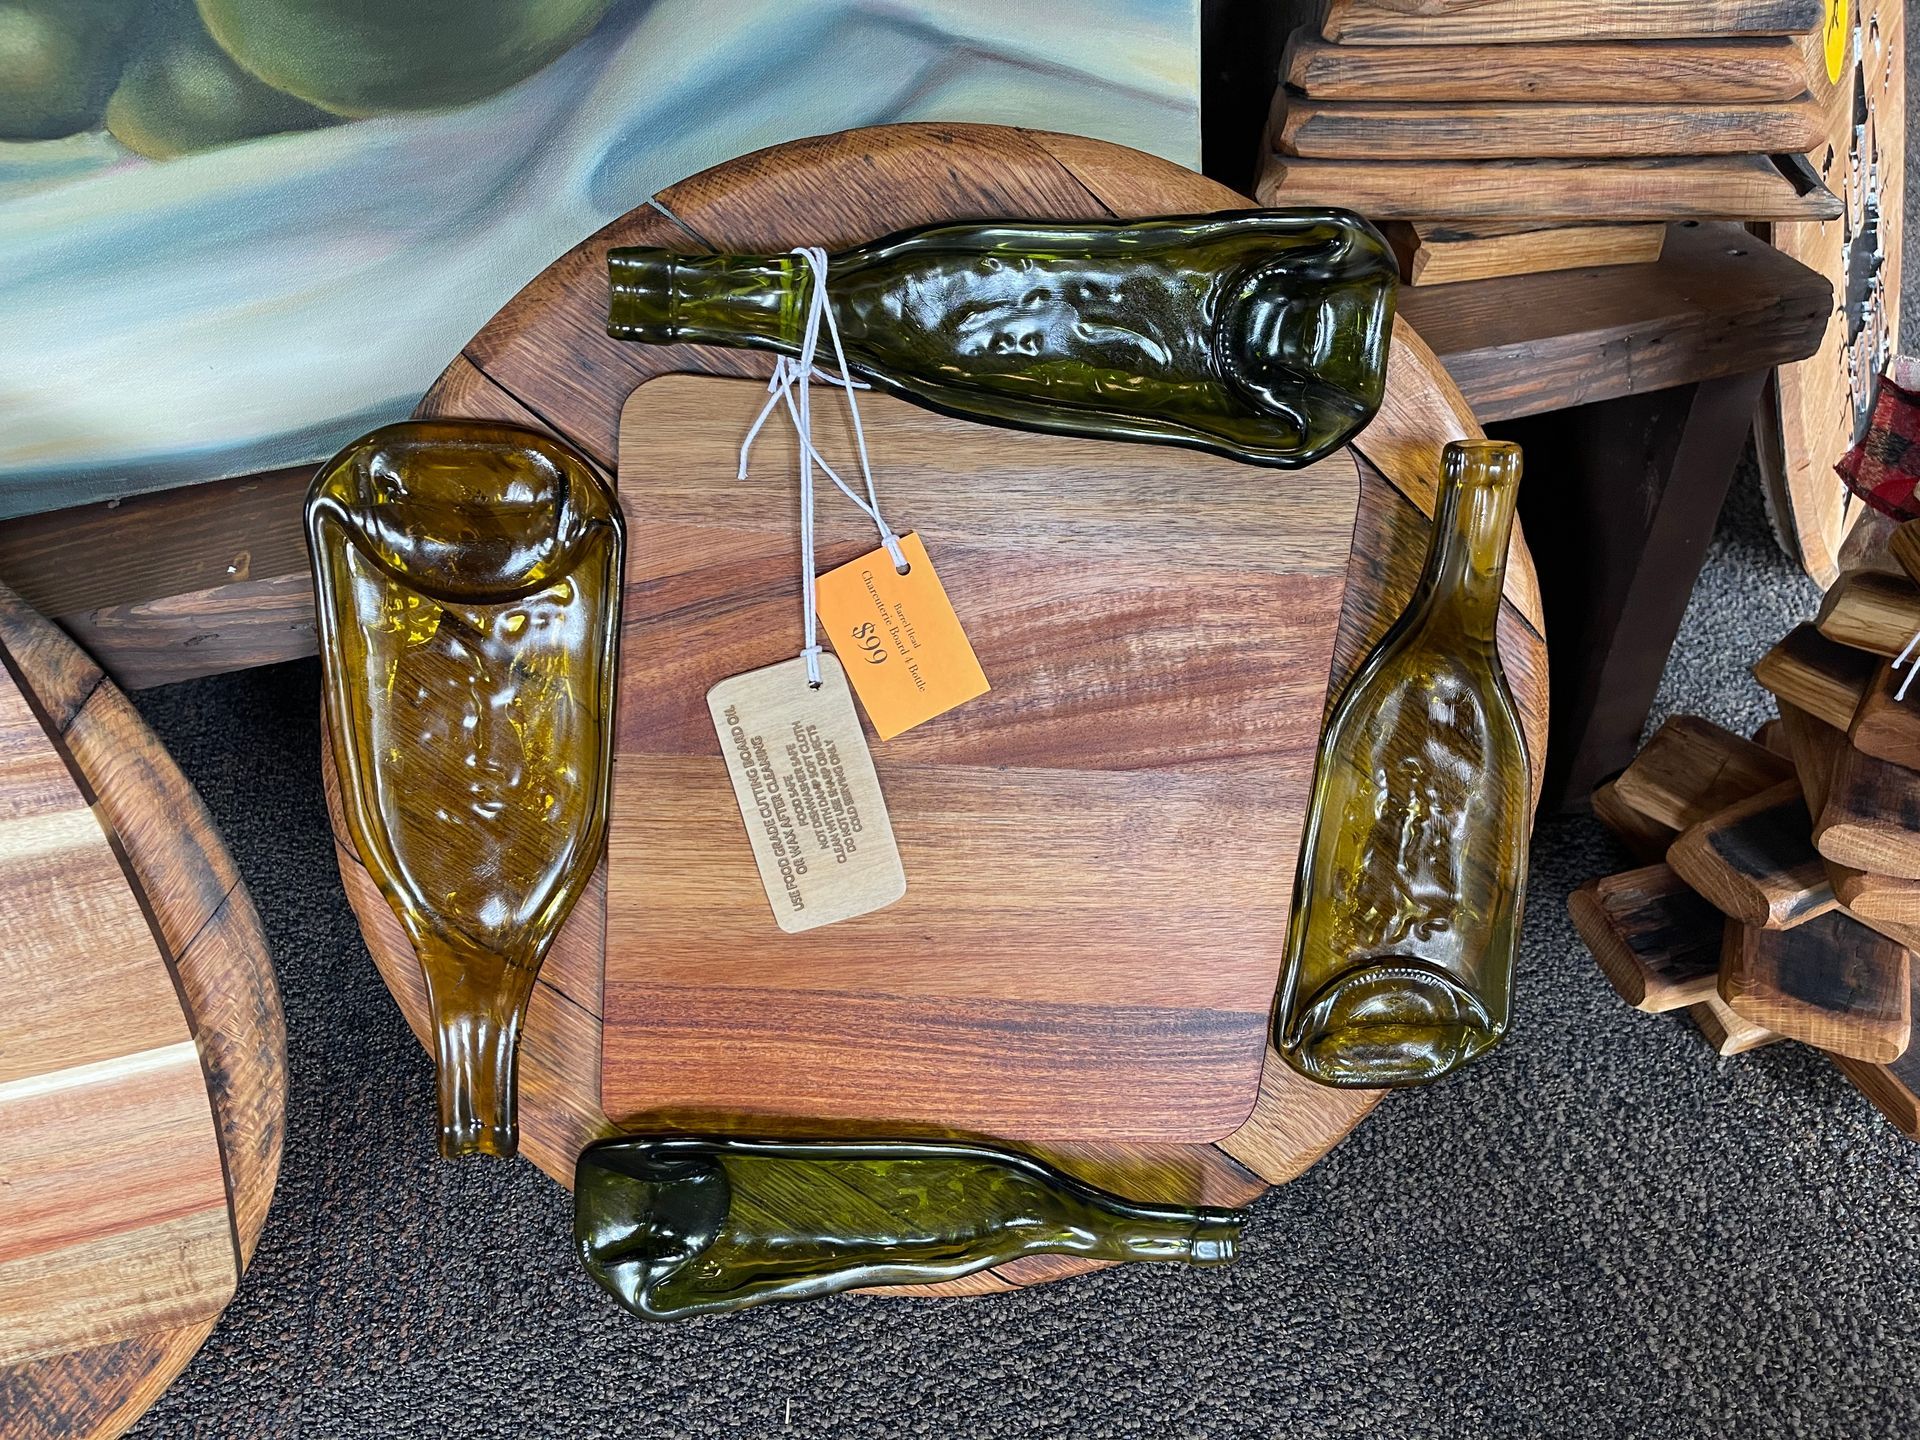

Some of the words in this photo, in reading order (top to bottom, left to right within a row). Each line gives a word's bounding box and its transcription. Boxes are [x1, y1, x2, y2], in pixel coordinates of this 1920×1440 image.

[861, 570, 893, 625] Charcuterie
[889, 626, 910, 656] Board
[908, 664, 926, 692] Bottle
[893, 603, 911, 628] Barrel
[906, 627, 922, 649] Head
[851, 622, 888, 664] $99
[724, 704, 740, 726] OIL
[731, 726, 755, 769] BOARD
[791, 720, 810, 754] CLOTH
[805, 724, 828, 767] OBJECTS
[750, 735, 780, 794] CLEANING
[785, 743, 802, 767] SAFE
[802, 755, 819, 779] SOFT
[823, 740, 841, 766] ONLY
[745, 768, 773, 819] CUTTING
[783, 774, 799, 799] SAFE
[811, 779, 829, 808] DAMP
[820, 767, 839, 798] SHARP
[832, 765, 855, 806] SERVING
[770, 793, 793, 828] AFTER
[793, 766, 823, 829] DISHWASHER
[830, 797, 845, 817] USE
[791, 798, 809, 827] FOOD
[820, 807, 838, 834] WITH
[846, 805, 863, 833] COLD
[763, 818, 786, 857] GRADE
[814, 829, 830, 850] NOT
[836, 817, 852, 838] NOT
[782, 829, 802, 858] WAX
[829, 833, 847, 864] CLEAN
[844, 837, 857, 853] DO
[777, 857, 798, 891] FOOD
[793, 857, 808, 875] OR
[788, 889, 805, 912] USE
